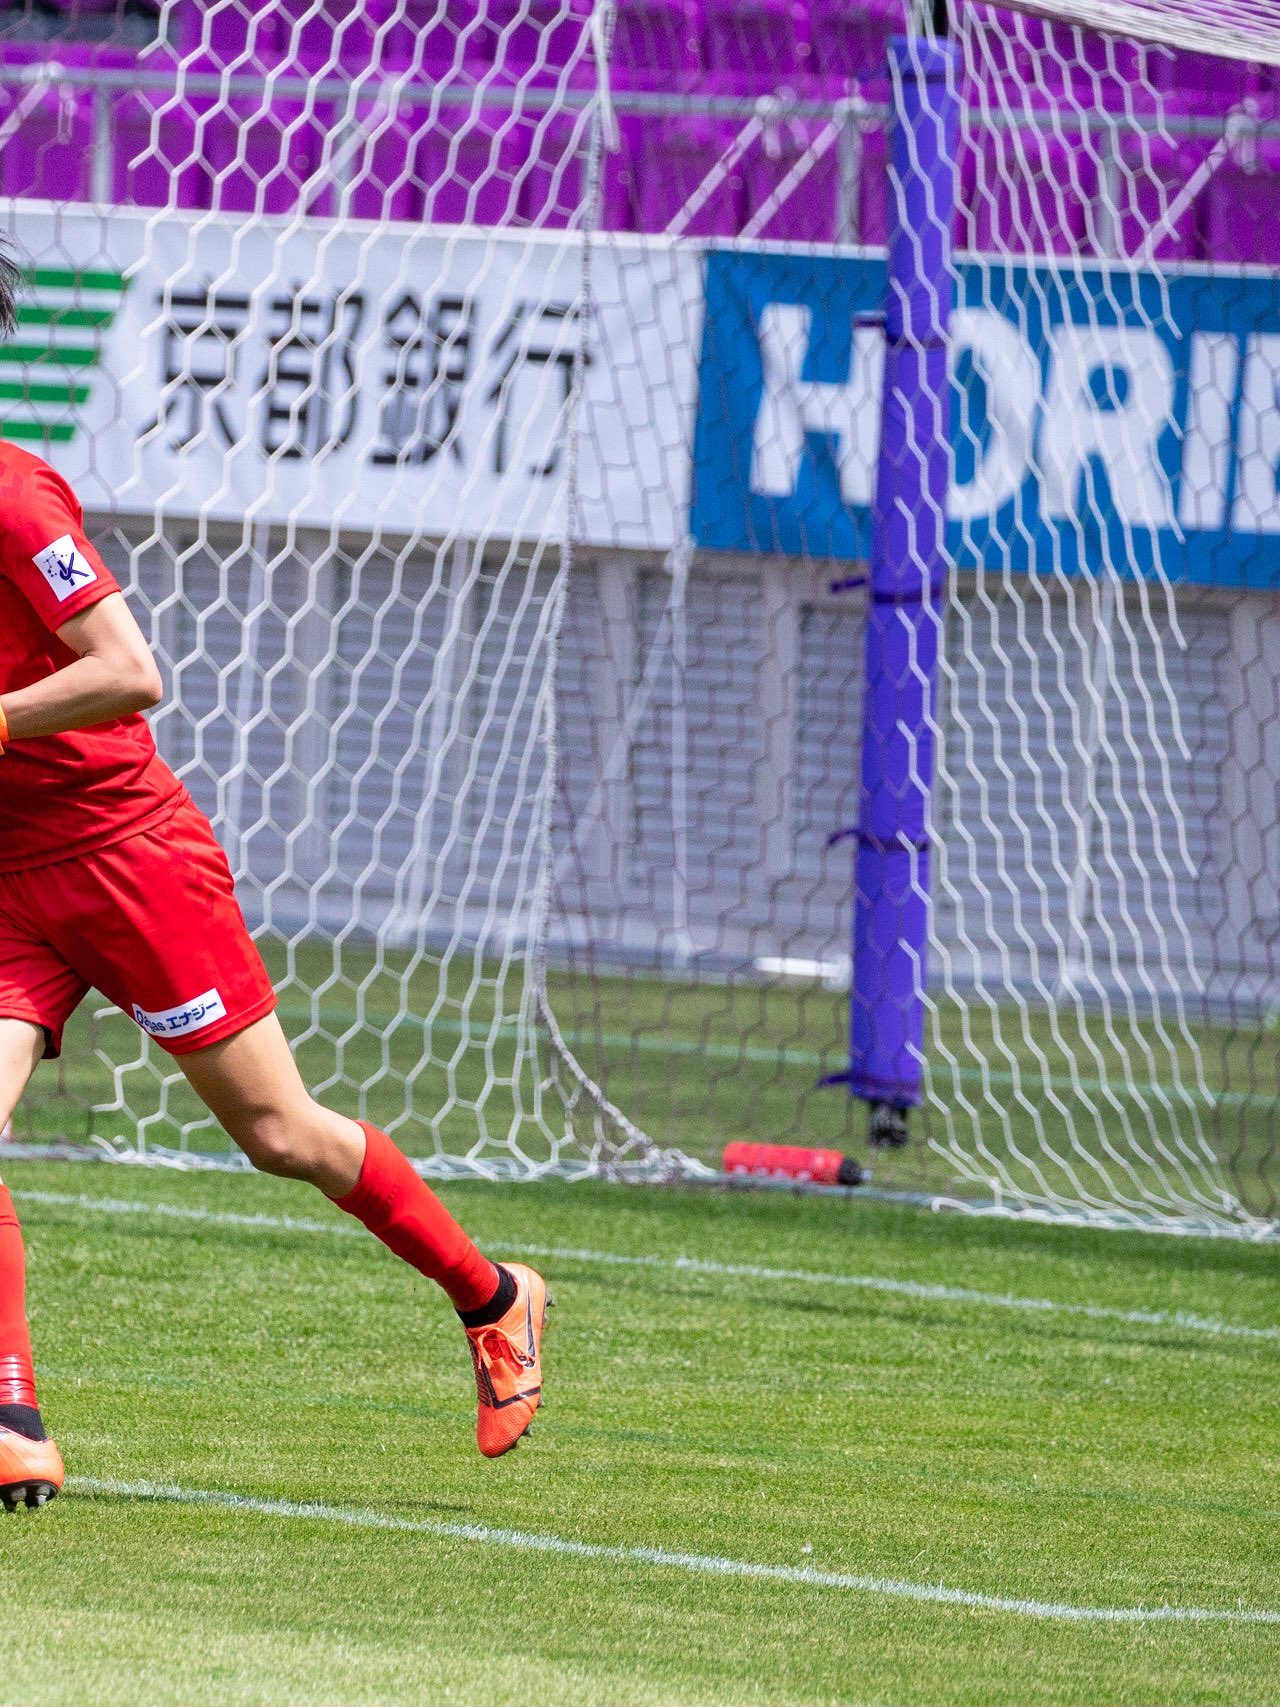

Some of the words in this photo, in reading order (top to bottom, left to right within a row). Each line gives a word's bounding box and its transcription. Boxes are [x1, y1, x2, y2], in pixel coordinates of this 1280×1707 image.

[137, 280, 589, 475] 京都銀行
[166, 1001, 218, 1030] エナジー
